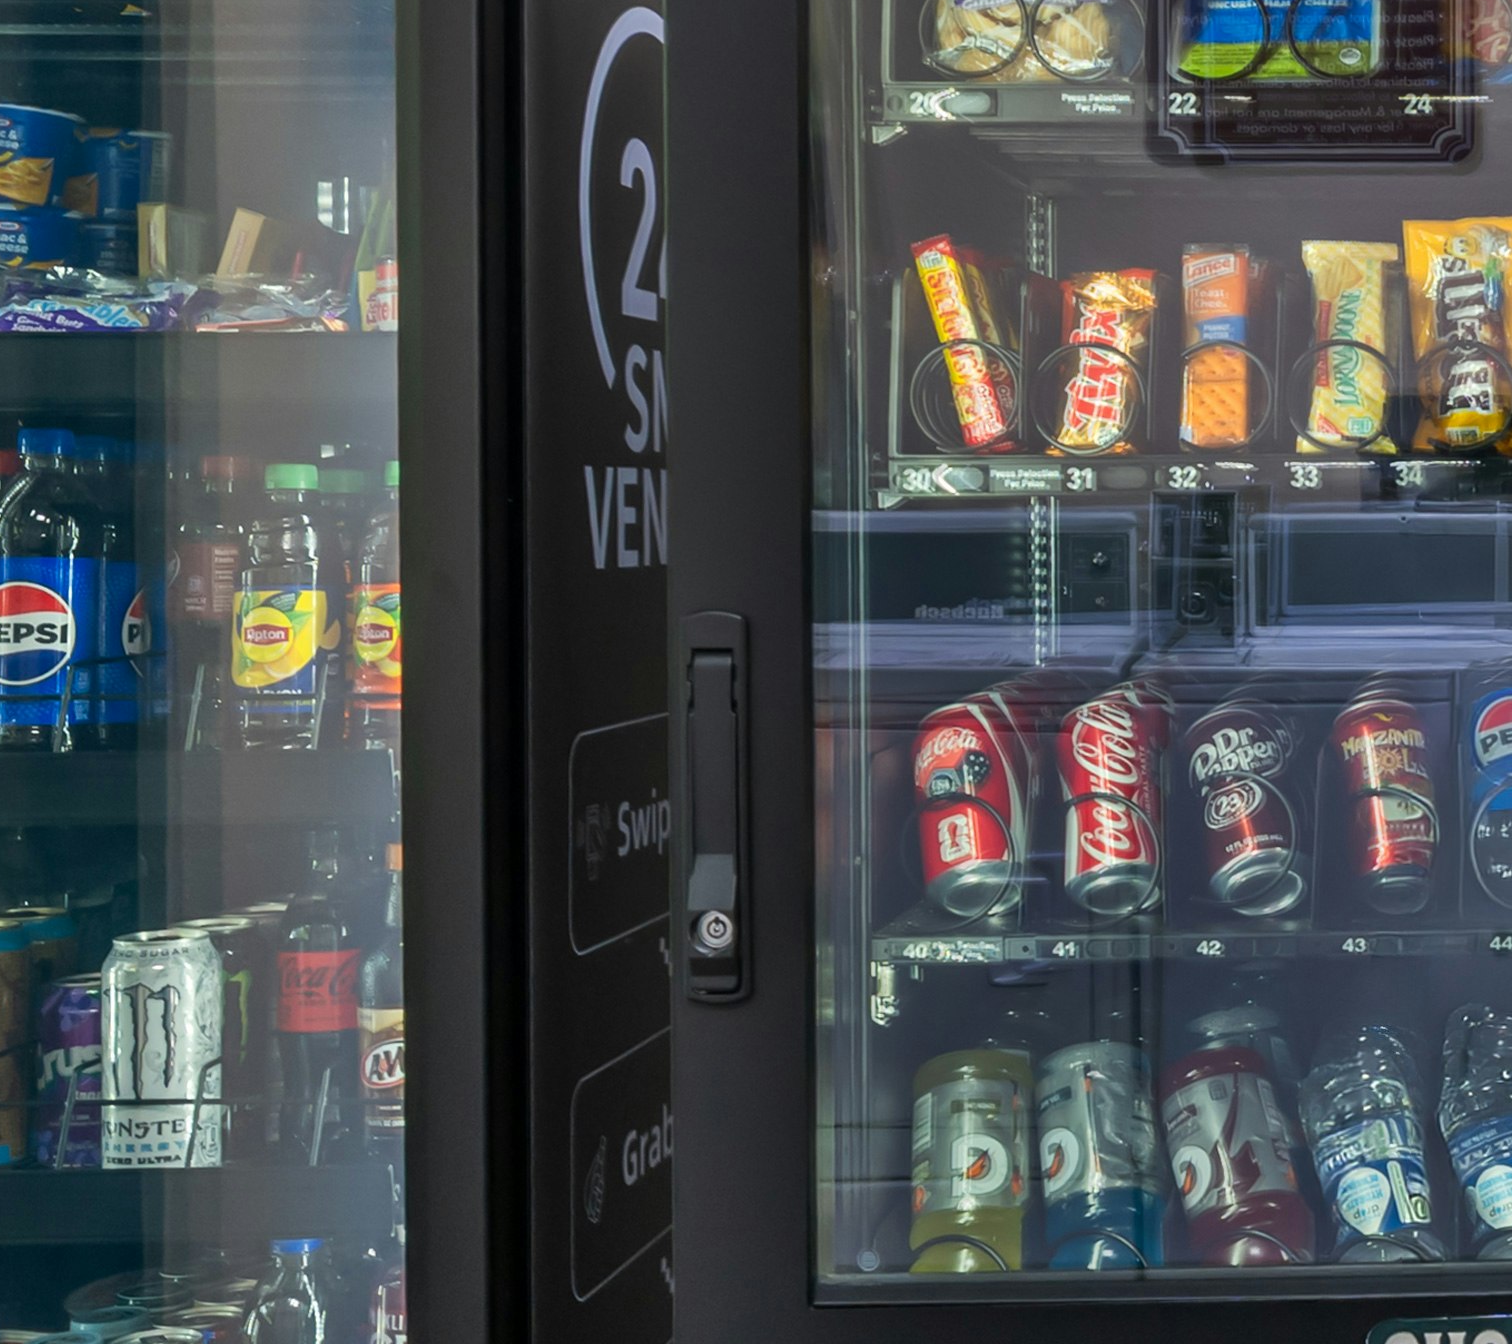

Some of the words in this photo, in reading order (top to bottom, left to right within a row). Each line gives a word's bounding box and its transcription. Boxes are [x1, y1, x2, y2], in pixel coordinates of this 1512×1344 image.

[1169, 93, 1197, 114] 22
[1403, 94, 1432, 114] 24
[1067, 468, 1093, 490] 31
[1169, 466, 1197, 488] 32
[1290, 466, 1319, 488] 33
[1395, 465, 1422, 487] 34
[1223, 727, 1254, 748] Dr
[1217, 792, 1240, 815] 23
[904, 942, 927, 958] 40
[1053, 942, 1076, 956] 41
[1197, 940, 1221, 955] 42
[1343, 938, 1366, 953] 43
[1490, 936, 1512, 950] 44
[137, 1154, 182, 1165] ULTRA
